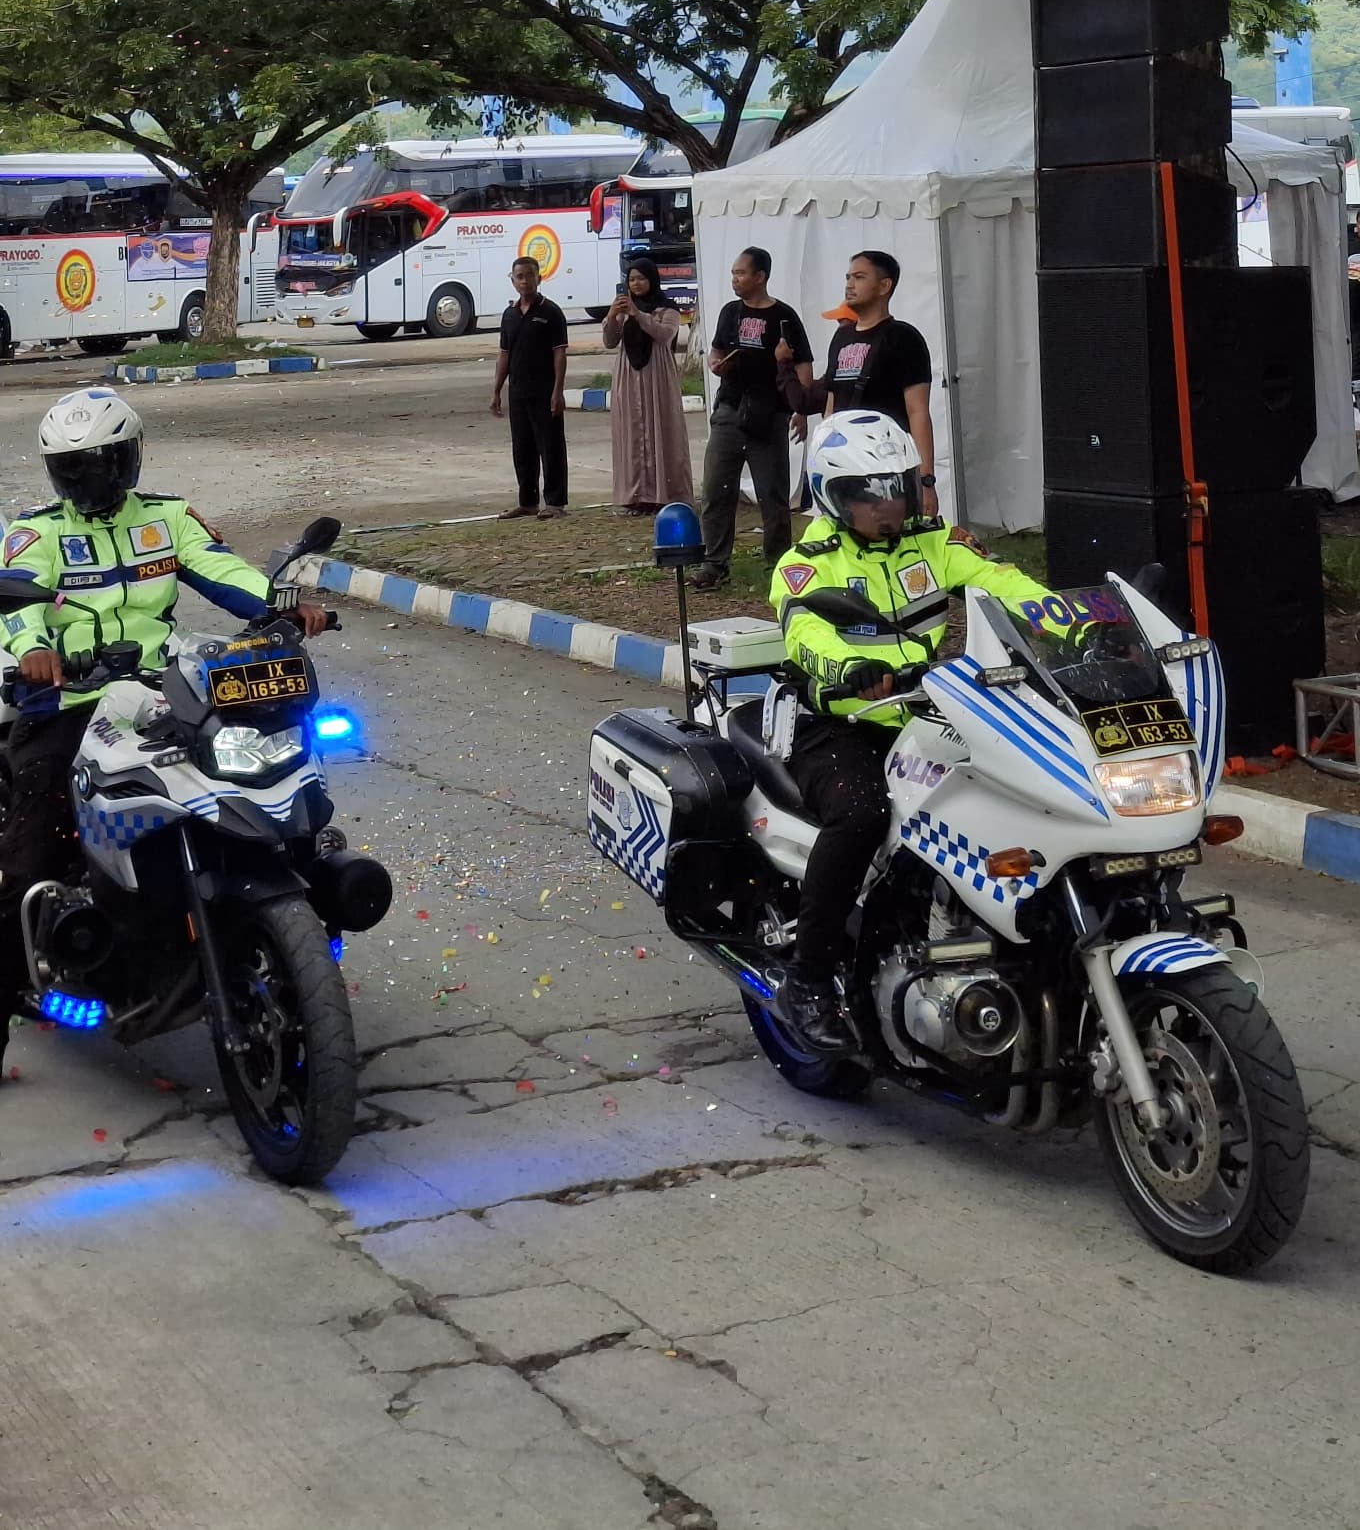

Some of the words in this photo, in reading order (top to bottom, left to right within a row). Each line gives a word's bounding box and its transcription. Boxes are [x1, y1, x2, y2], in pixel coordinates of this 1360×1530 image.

[457, 224, 504, 236] PRAYOGO
[140, 557, 176, 578] POLISI
[267, 662, 285, 677] IX
[251, 677, 306, 698] 165-53
[1142, 703, 1164, 721] IX
[88, 715, 127, 748] POLISI
